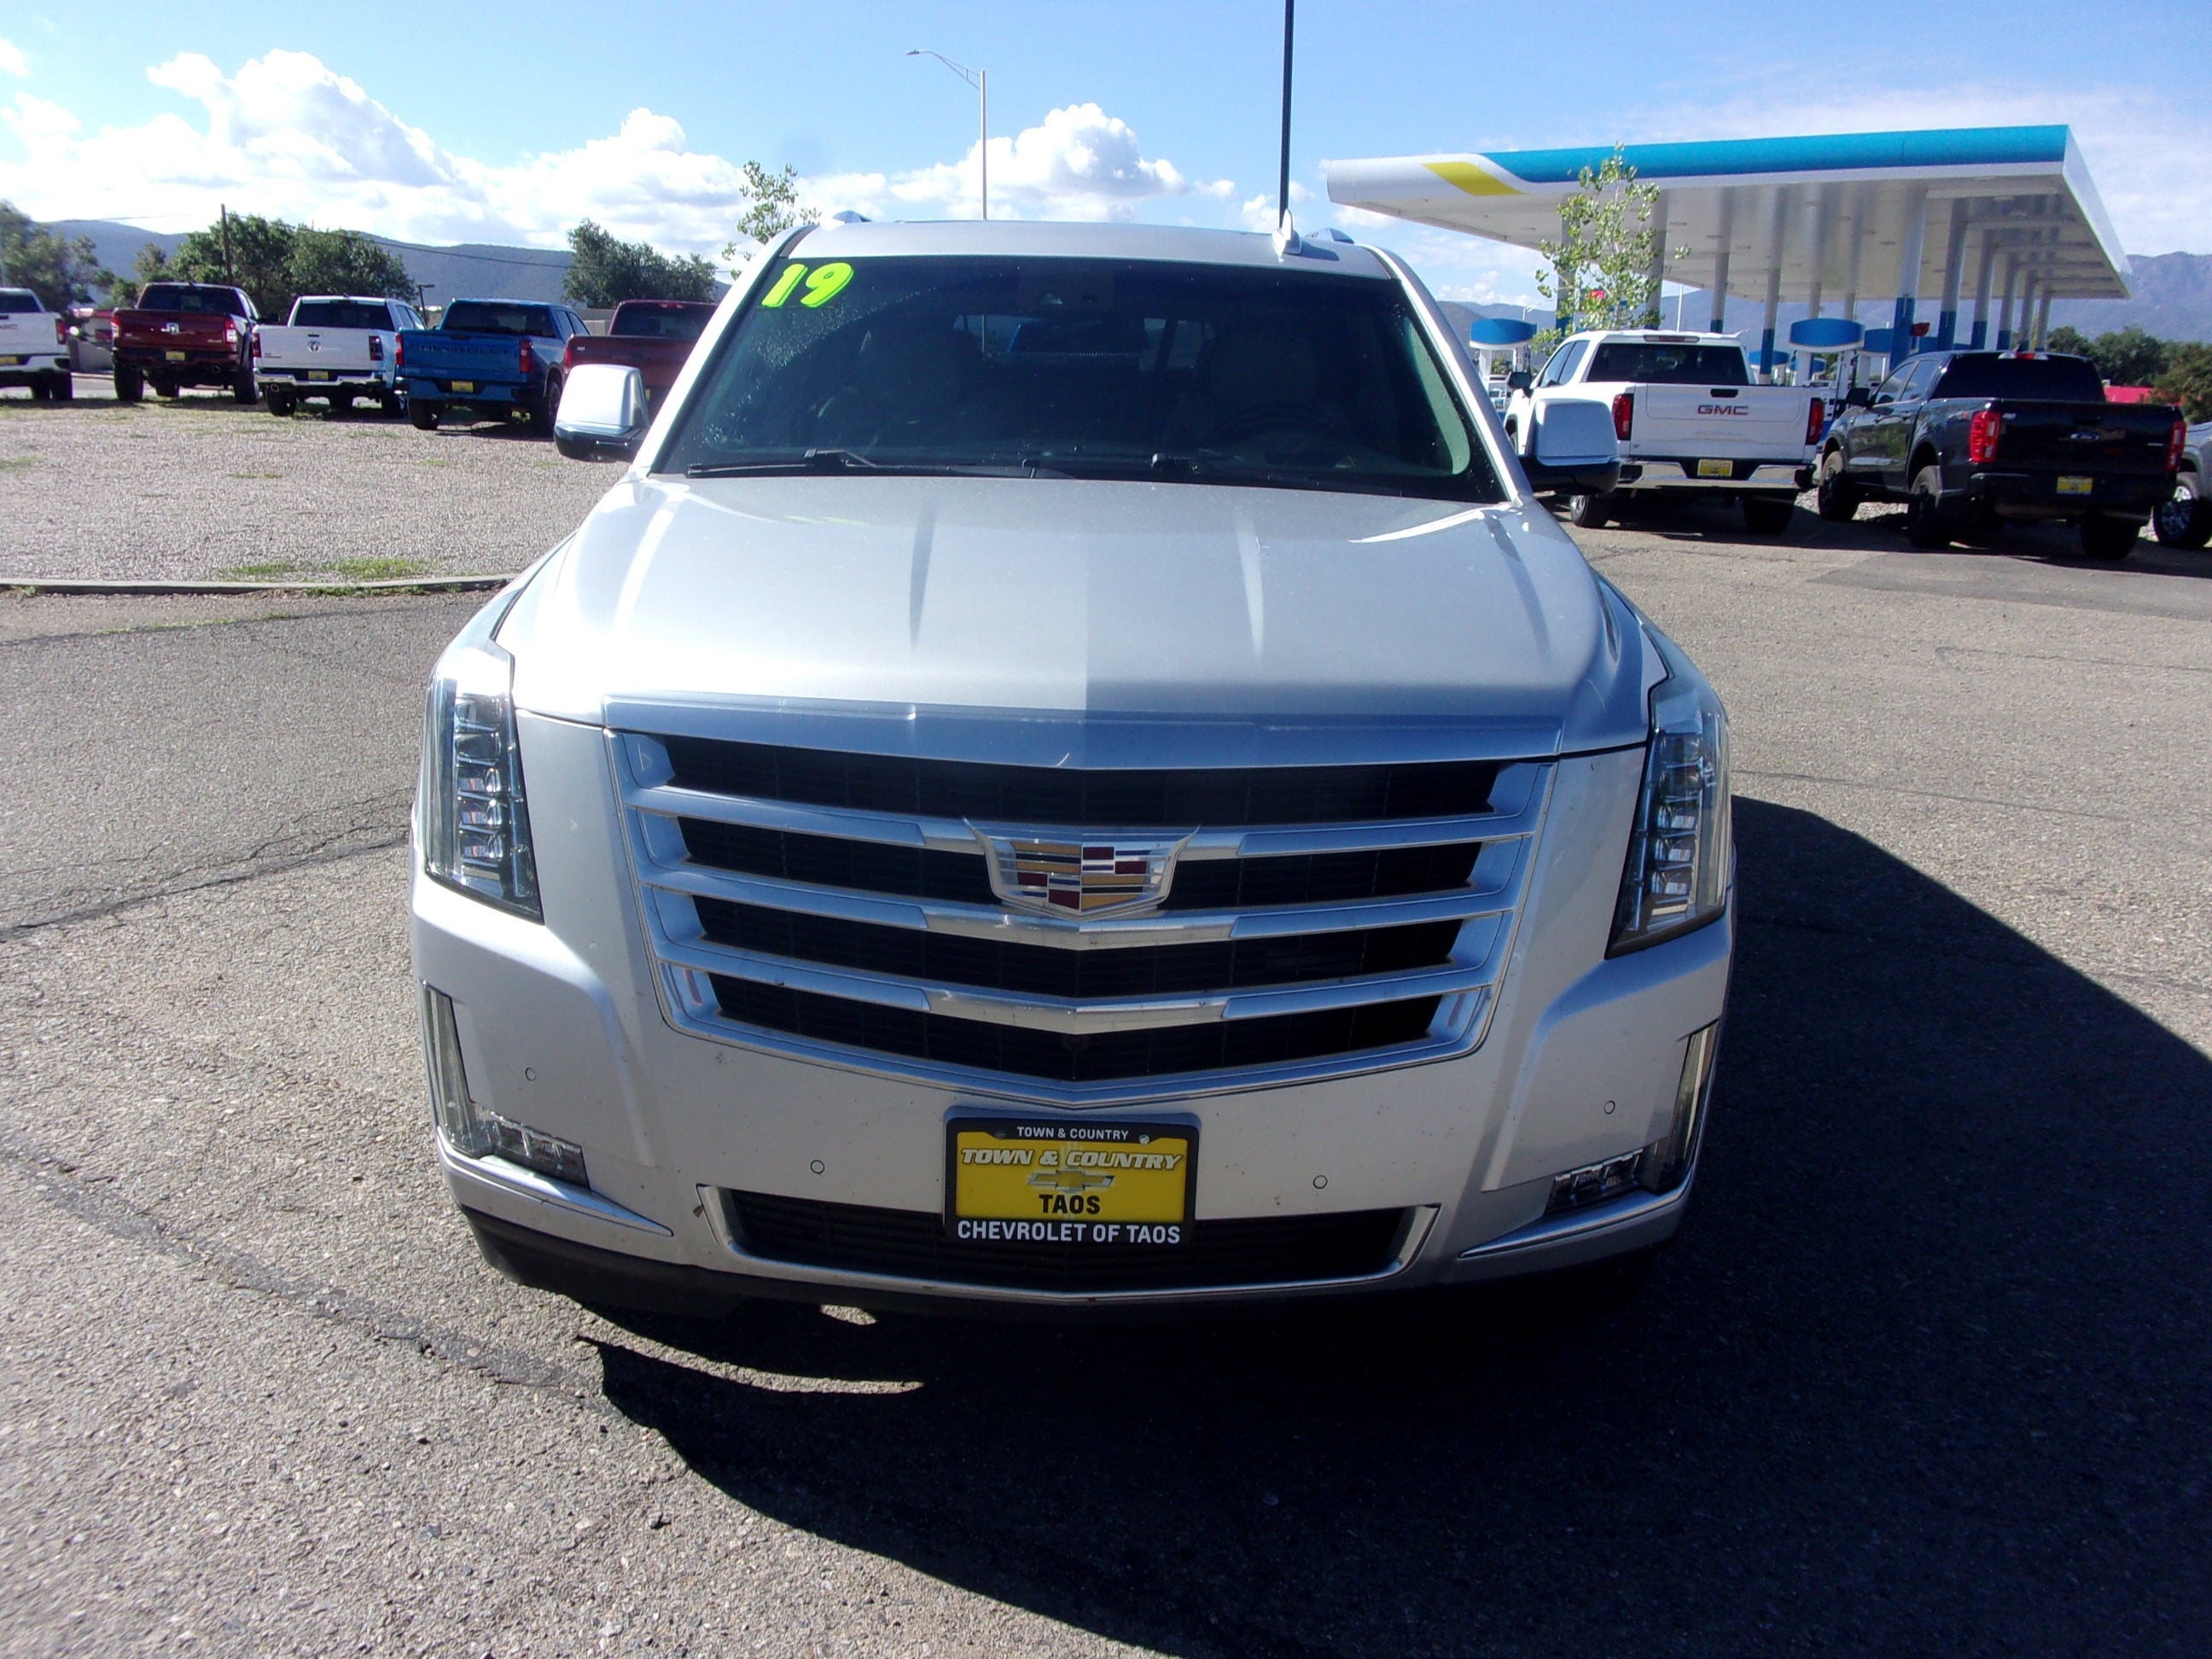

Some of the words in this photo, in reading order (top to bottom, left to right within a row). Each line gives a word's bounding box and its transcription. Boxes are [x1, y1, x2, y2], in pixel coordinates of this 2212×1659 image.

[761, 262, 854, 308] 19
[1697, 405, 1749, 416] GMC
[1017, 1126, 1055, 1138] TOWN
[1057, 1127, 1066, 1138] &
[1069, 1128, 1130, 1141] COUNTRY
[961, 1149, 1033, 1166] TOWN
[1039, 1150, 1059, 1167] &
[1066, 1150, 1183, 1170] COUNTRY
[1039, 1194, 1101, 1215] TAOS
[957, 1220, 1087, 1242] CHEVROLET
[1092, 1224, 1121, 1243] OF
[1126, 1225, 1181, 1244] TAOS
